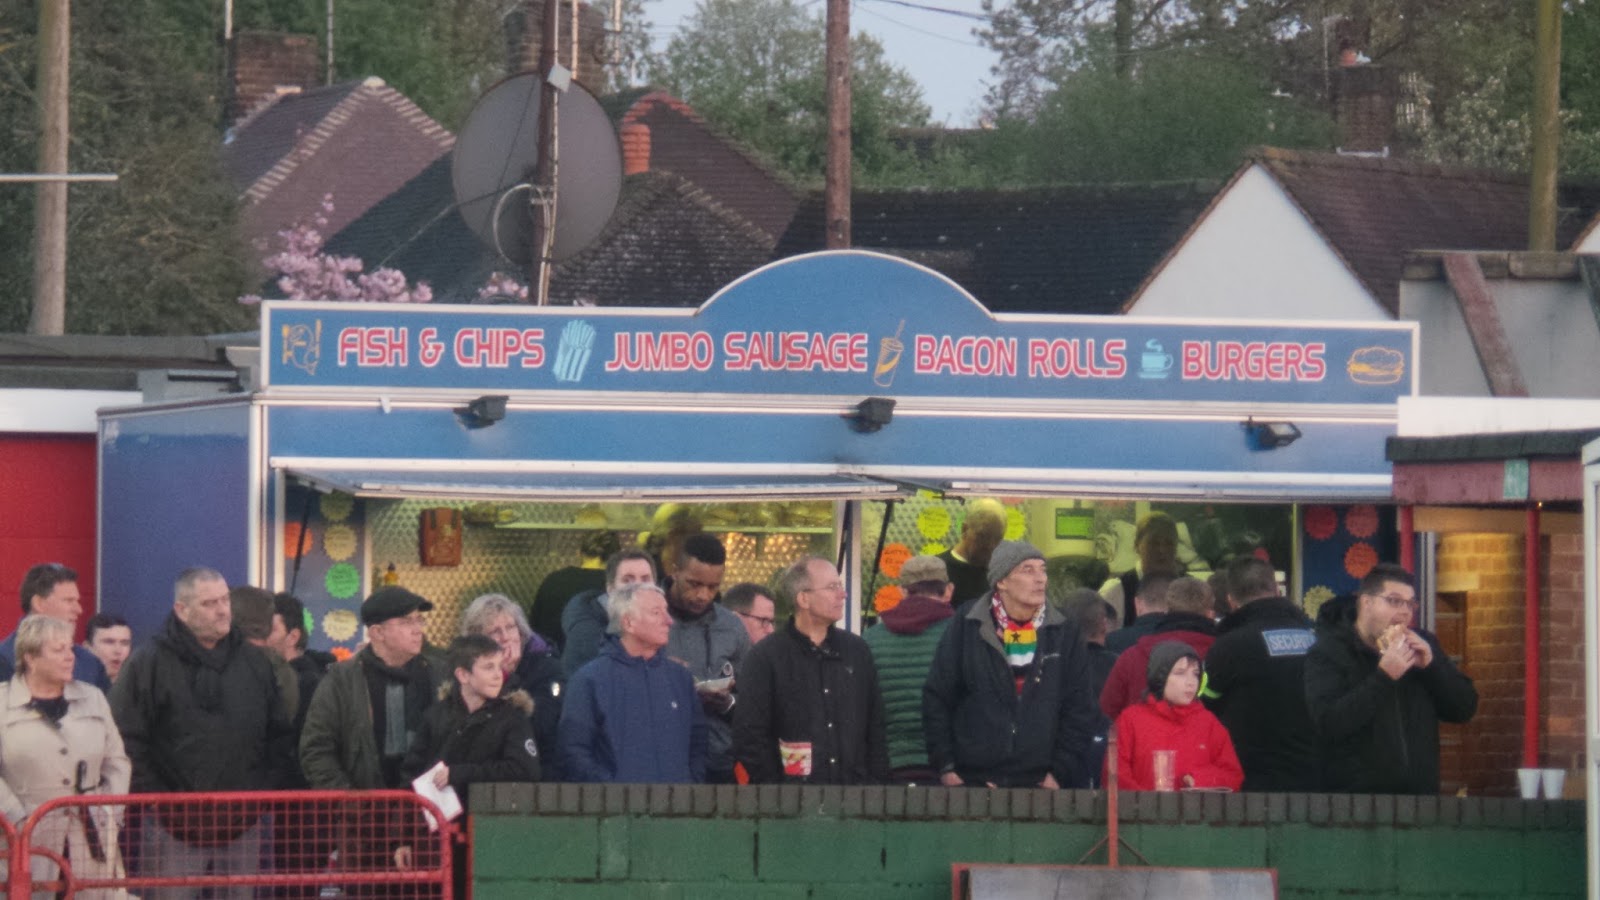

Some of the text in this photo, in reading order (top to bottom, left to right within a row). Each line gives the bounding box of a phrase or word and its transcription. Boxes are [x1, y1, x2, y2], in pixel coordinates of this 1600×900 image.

[337, 326, 1327, 382] FISH & CHIPS JUMBO SAUSAGE BACON ROLLS BURGERS
